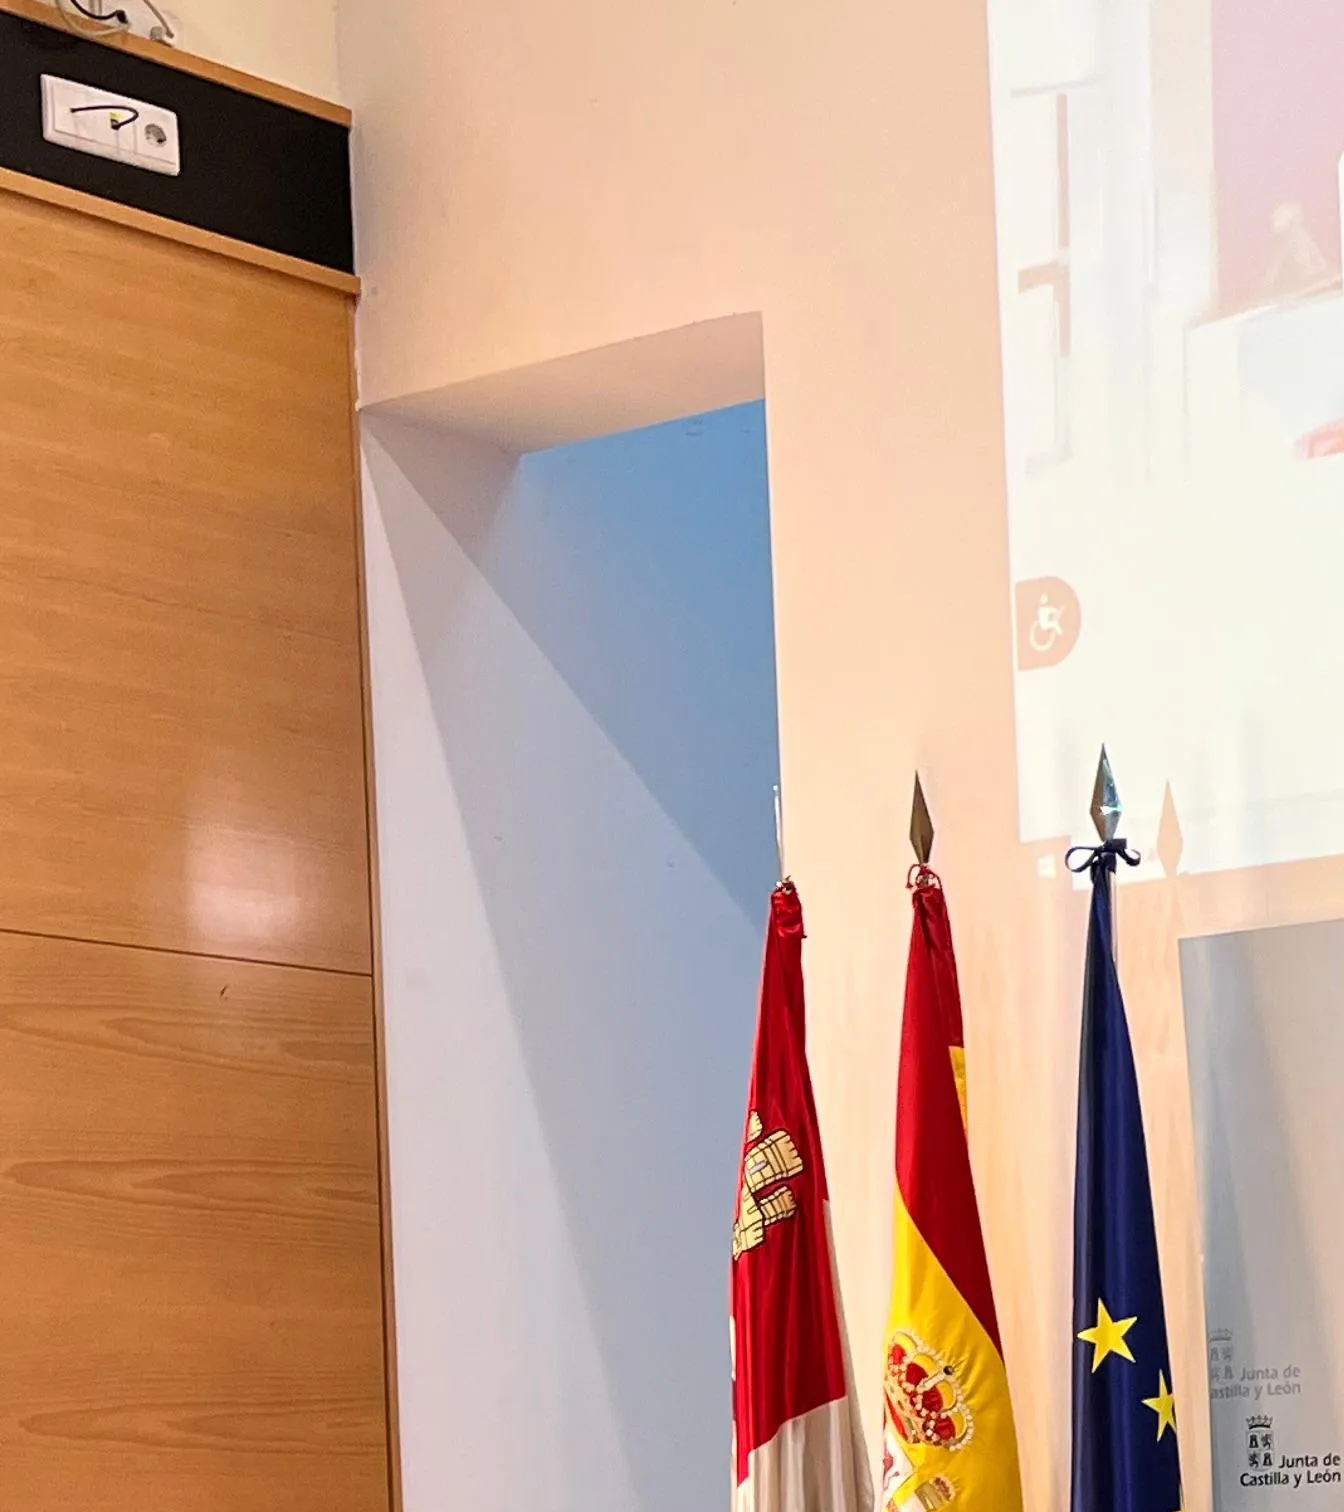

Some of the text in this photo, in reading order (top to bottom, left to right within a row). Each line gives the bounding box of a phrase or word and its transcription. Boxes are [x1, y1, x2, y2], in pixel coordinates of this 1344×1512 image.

[1279, 1453, 1341, 1469] Junta de
[1240, 1468, 1341, 1489] Castilla y León
